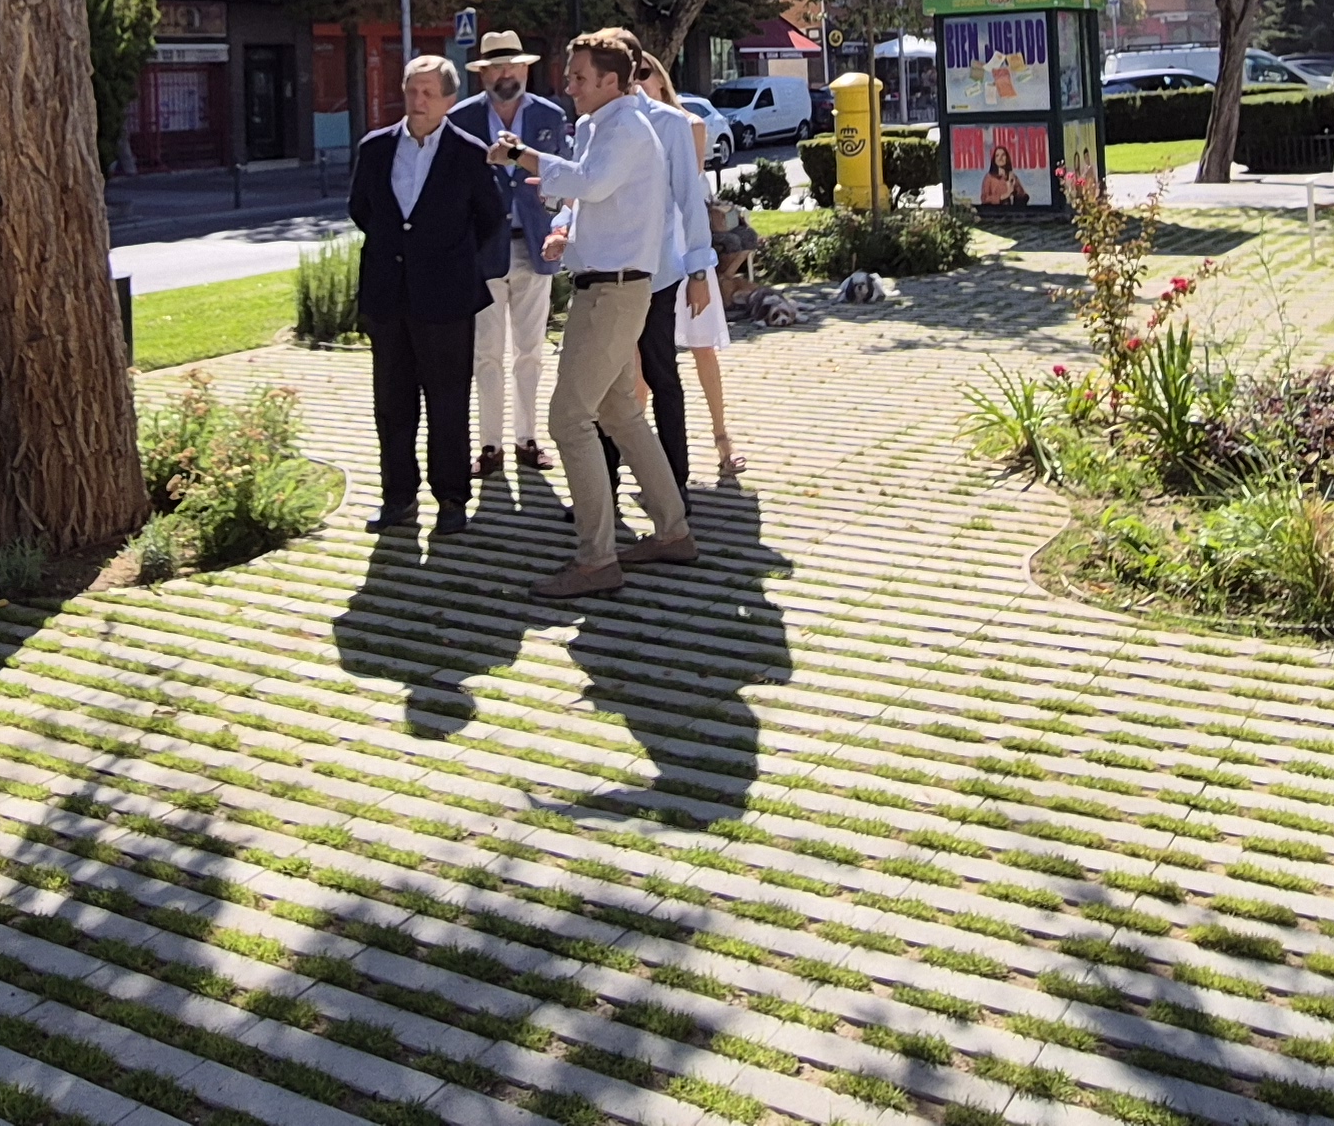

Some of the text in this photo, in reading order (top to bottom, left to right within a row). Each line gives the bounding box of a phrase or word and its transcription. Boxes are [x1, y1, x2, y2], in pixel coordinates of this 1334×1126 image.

[945, 18, 1046, 69] BIEN JUGADO
[952, 125, 1047, 170] BIEN JUGADO
